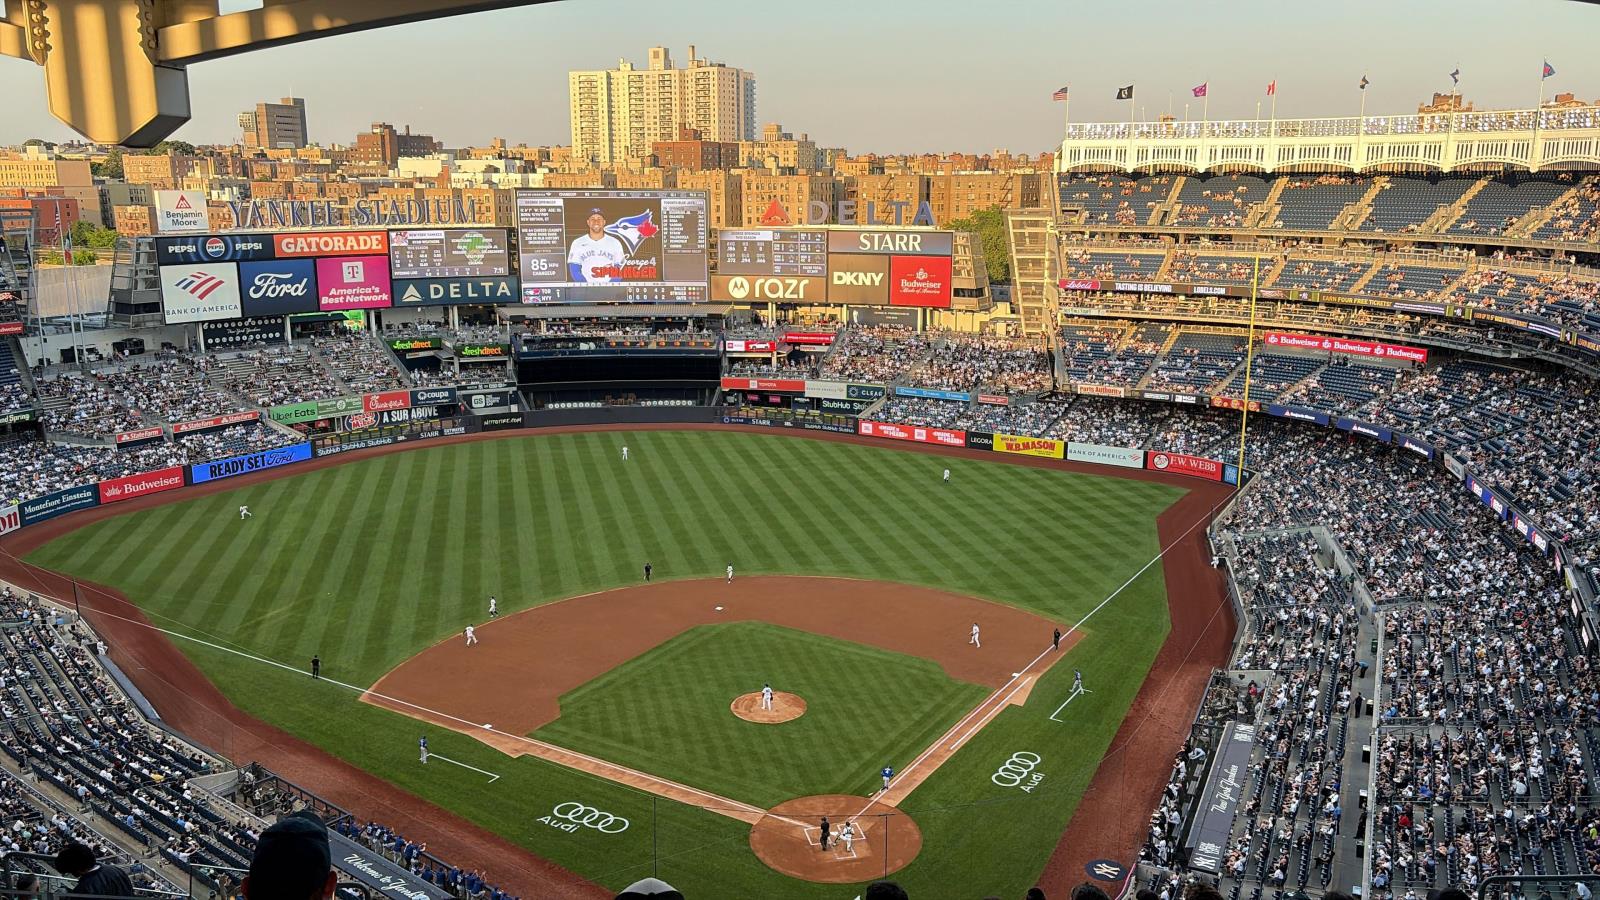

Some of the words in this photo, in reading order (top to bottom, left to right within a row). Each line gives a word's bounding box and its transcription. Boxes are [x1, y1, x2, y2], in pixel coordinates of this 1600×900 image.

[166, 210, 203, 219] Benjamin
[228, 200, 340, 228] YANKEE
[354, 198, 478, 226] STADIUM
[809, 200, 935, 225] DELTA
[168, 245, 196, 253] PEPSI
[281, 235, 382, 253] GATORADE
[859, 234, 922, 251] STARR
[531, 259, 548, 270] 85
[620, 254, 649, 270] George
[650, 257, 656, 266] 4
[591, 266, 656, 278] SPRINGER
[833, 272, 884, 286] DKNY
[249, 273, 308, 299] Ford
[329, 286, 380, 295] America's
[430, 282, 511, 299] DELTA
[755, 278, 809, 298] razr
[901, 279, 941, 289] Budweiser
[1115, 283, 1137, 291] TASTING
[1144, 284, 1172, 292] BELIEVING
[322, 296, 338, 304] Best
[340, 294, 388, 303] Network
[203, 305, 238, 313] AMERICA
[393, 341, 432, 350] freshdirect
[462, 347, 502, 355] freshdirect
[1280, 336, 1319, 346] Budweiser
[1334, 342, 1372, 352] Budweiser
[1387, 348, 1424, 359] Budweiser
[1095, 387, 1121, 395] Authority
[370, 396, 404, 409] Chick-fil-A
[822, 400, 850, 409] StubHub
[9, 414, 30, 423] Spring
[272, 412, 292, 420] Uber
[295, 408, 315, 417] Eats
[383, 413, 389, 423] A
[411, 407, 438, 419] ABOVE
[317, 447, 340, 456] StubHub
[342, 442, 365, 452] StubHub
[368, 438, 391, 447] StubHub
[1023, 441, 1056, 450] MASON
[209, 459, 244, 479] READY
[247, 455, 267, 470] SET
[267, 450, 295, 465] Ford
[1170, 456, 1187, 466] F.W.
[1190, 459, 1216, 471] WEBB
[124, 476, 180, 494] Budweiser
[24, 500, 61, 514] Montefiore
[62, 490, 92, 502] Einstein
[1020, 772, 1046, 793] Audi
[1220, 764, 1240, 788] Yankees
[1216, 784, 1236, 803] York
[1211, 803, 1227, 813] New
[536, 816, 580, 833] Audi
[344, 854, 381, 878] Welcome
